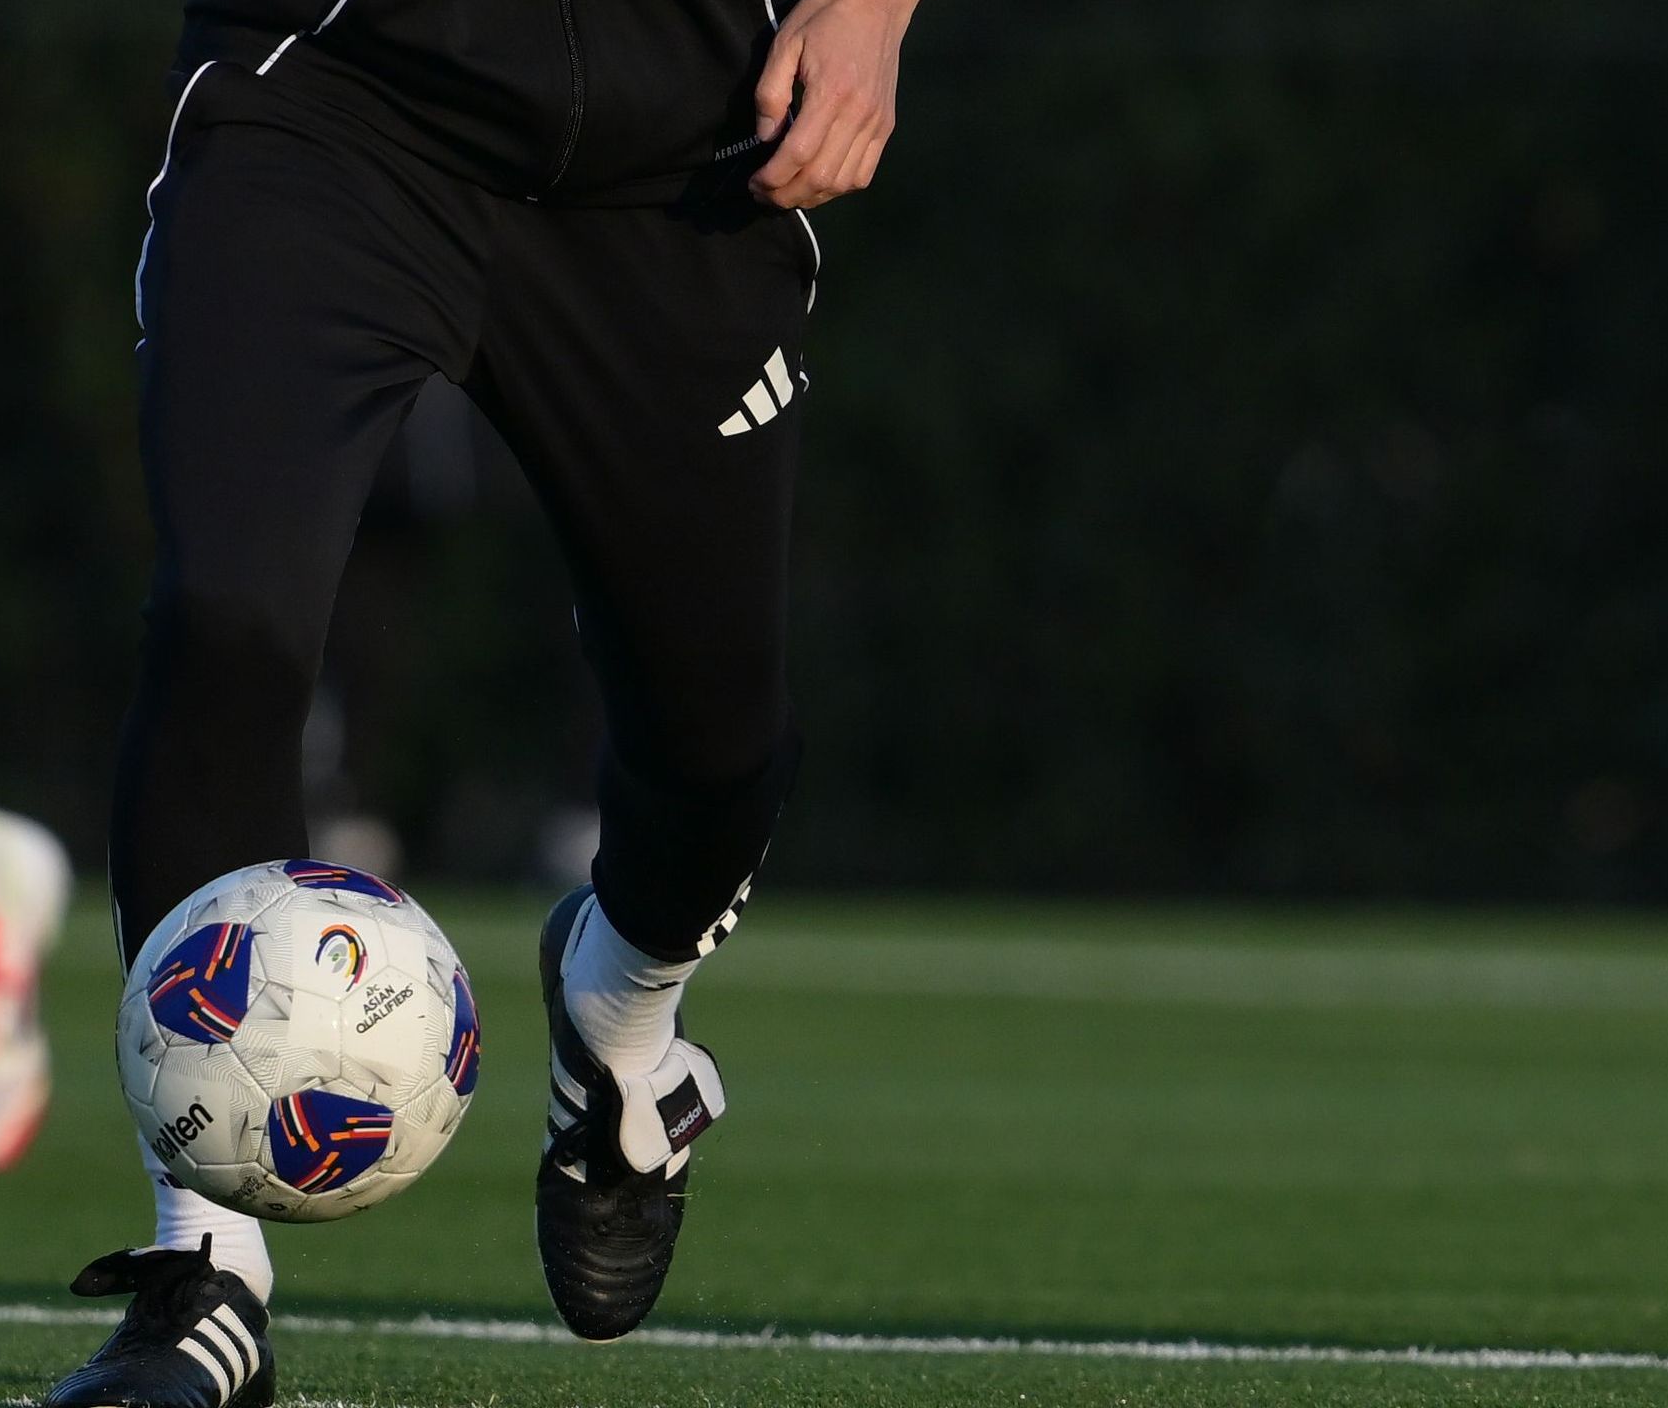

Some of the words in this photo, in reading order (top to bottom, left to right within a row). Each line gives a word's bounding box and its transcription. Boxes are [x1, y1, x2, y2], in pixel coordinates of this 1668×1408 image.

[715, 135, 761, 161] AEROREAD
[356, 985, 414, 1033] QUALIFIERS
[363, 985, 395, 1015] ASIAN
